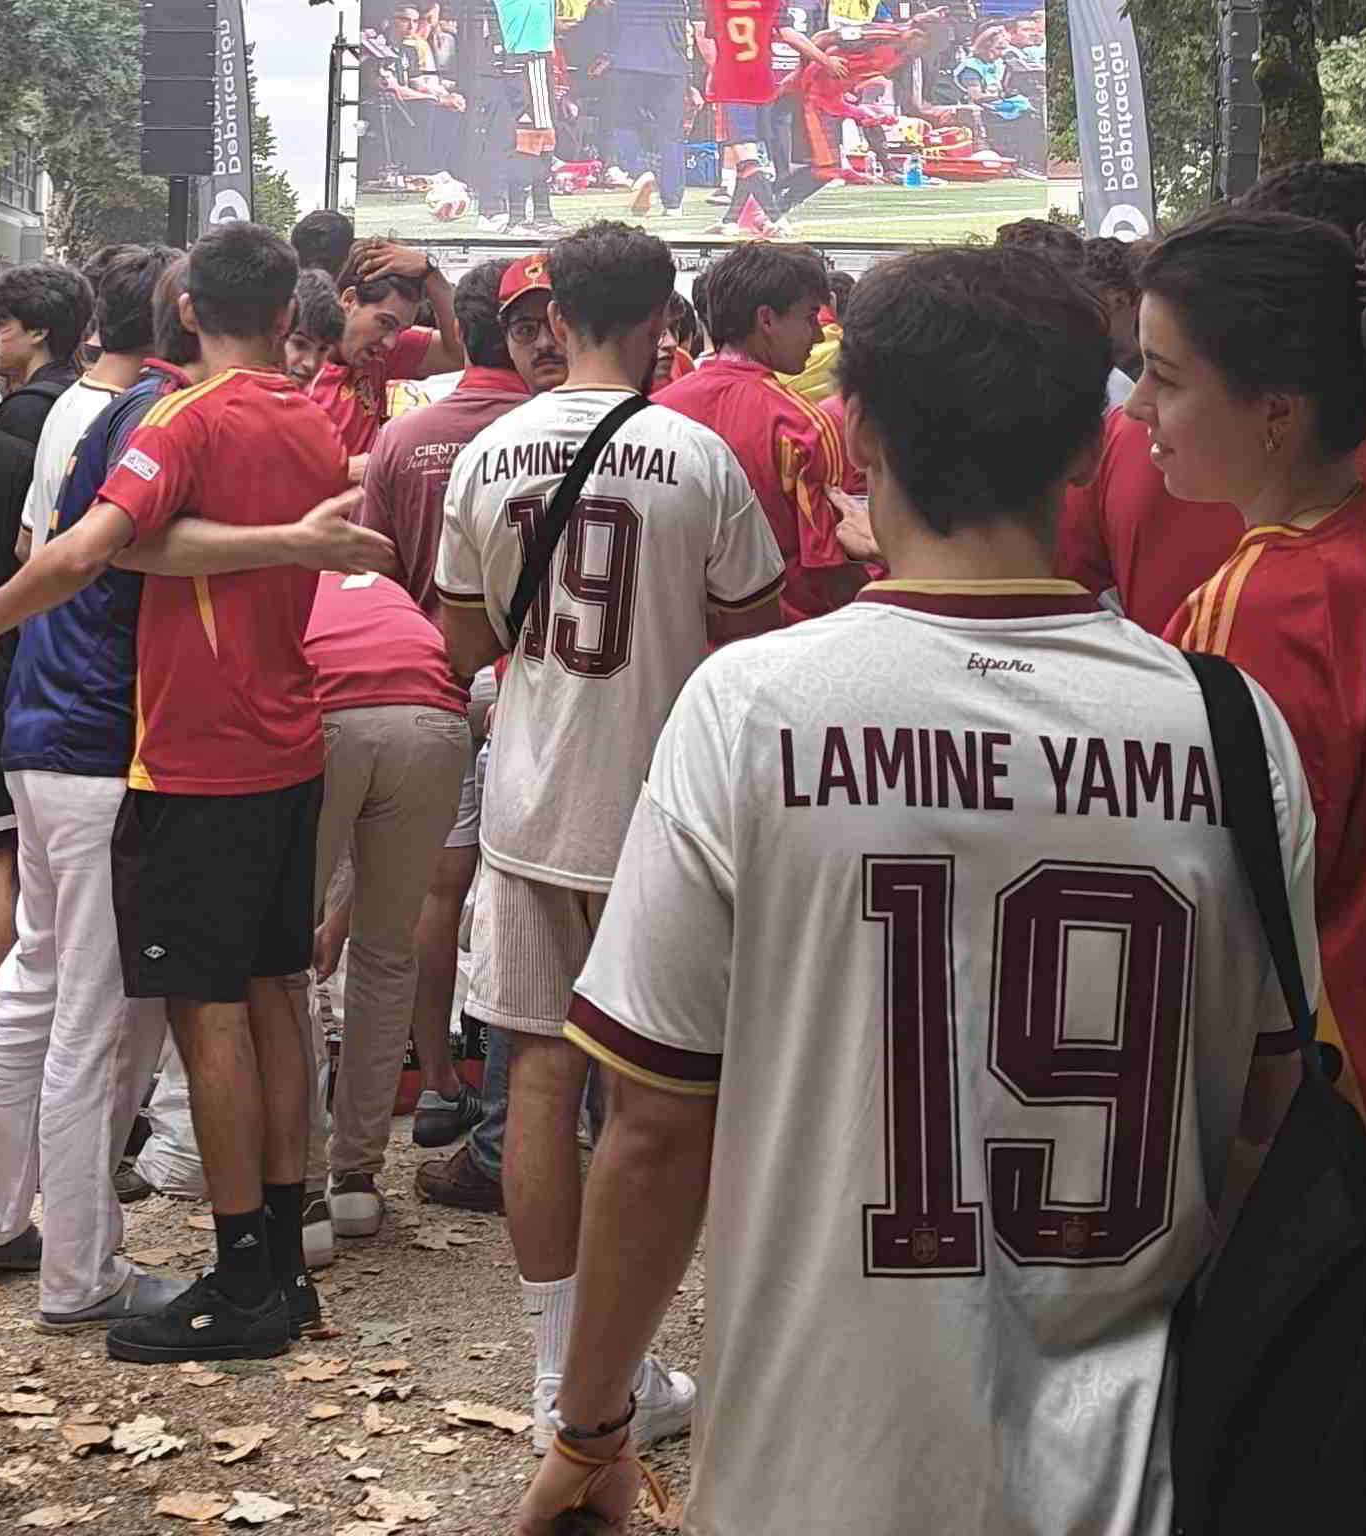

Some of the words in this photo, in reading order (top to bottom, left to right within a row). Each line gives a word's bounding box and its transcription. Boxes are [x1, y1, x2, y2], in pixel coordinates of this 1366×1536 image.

[726, 16, 760, 62] 9
[482, 440, 577, 486] LAMINE
[591, 441, 679, 486] AMAL
[505, 493, 644, 680] 19
[967, 651, 1036, 678] España
[779, 726, 1014, 811] LAMINE
[1039, 735, 1236, 829] YAMA
[862, 854, 1197, 1279] 19
